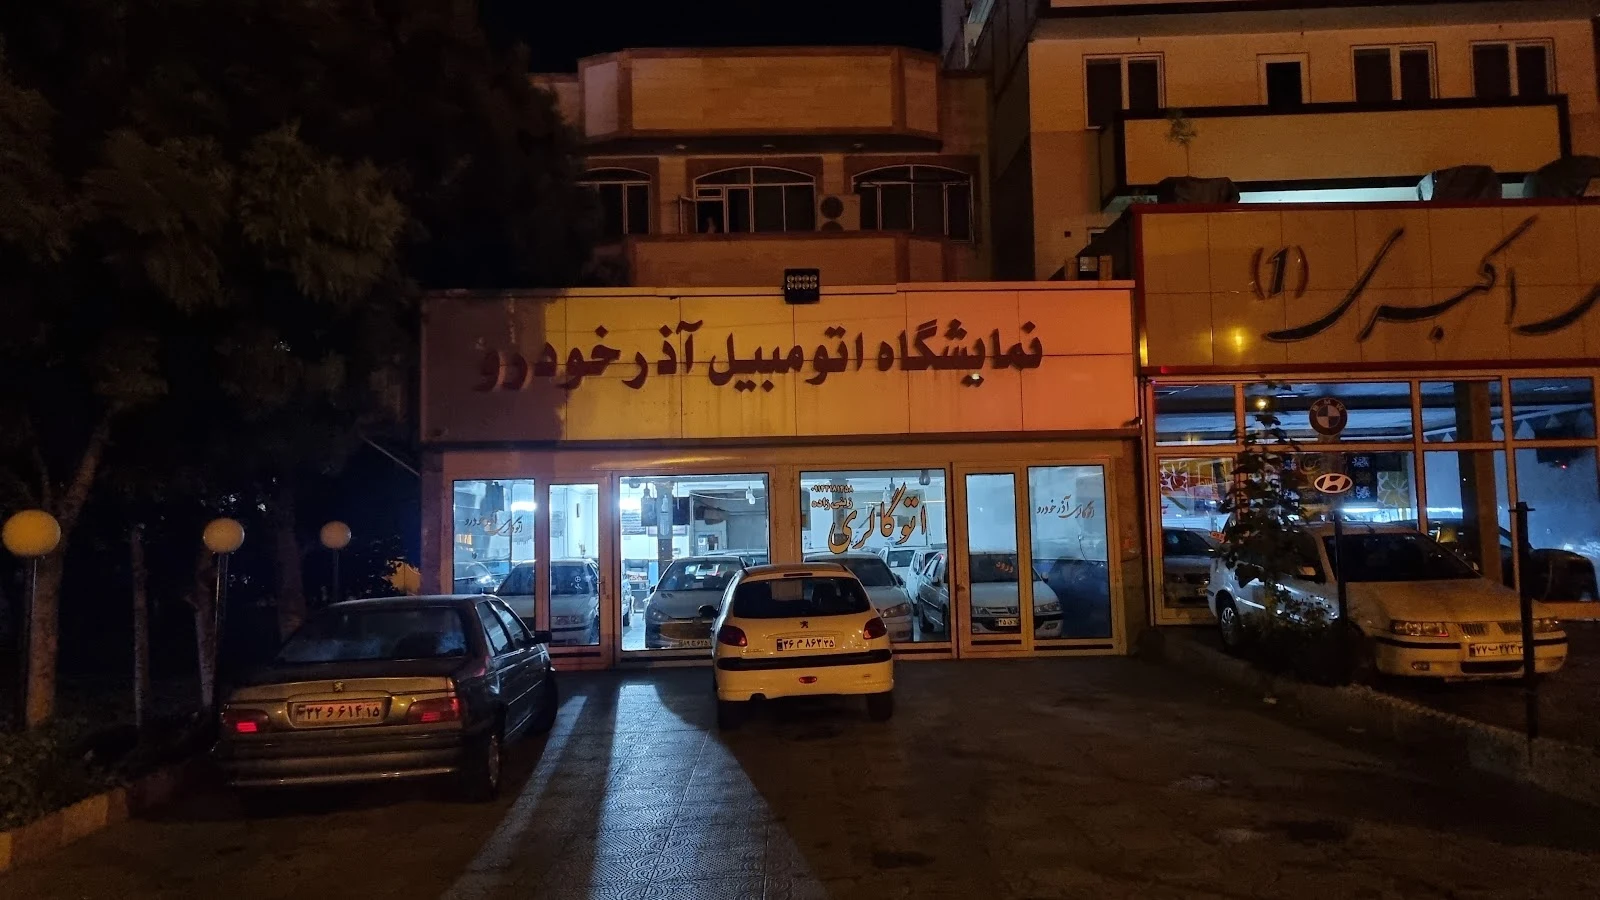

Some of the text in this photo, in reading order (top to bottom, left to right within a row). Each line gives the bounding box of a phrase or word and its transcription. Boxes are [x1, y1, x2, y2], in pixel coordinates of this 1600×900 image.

[472, 318, 1043, 393] نمایشگاه اتومبیل آذر خودرو
